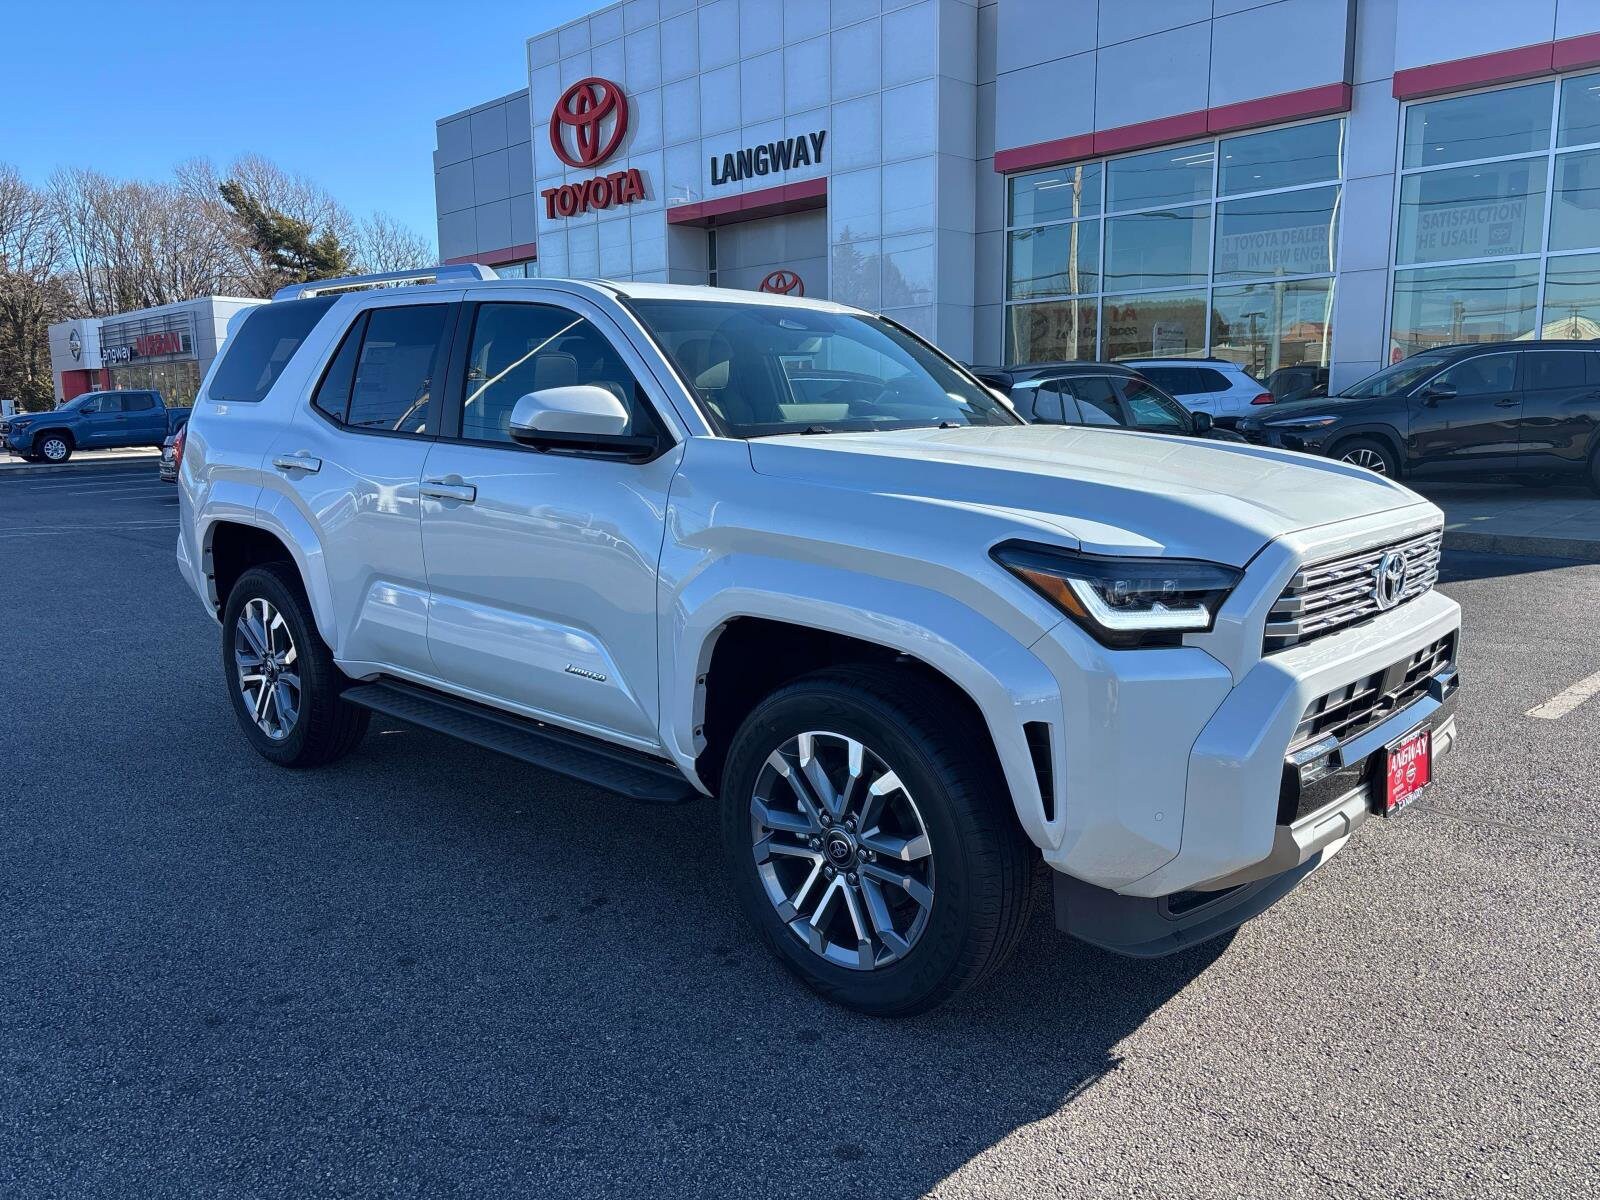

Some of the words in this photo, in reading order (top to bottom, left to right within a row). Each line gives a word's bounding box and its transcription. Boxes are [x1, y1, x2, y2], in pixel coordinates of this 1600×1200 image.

[711, 130, 827, 185] LANGWAY
[541, 168, 646, 220] TOYOTA
[1232, 231, 1278, 252] TOYOTA
[1281, 226, 1326, 248] DEALER
[1053, 304, 1137, 324] TYTA
[100, 345, 132, 364] Langway
